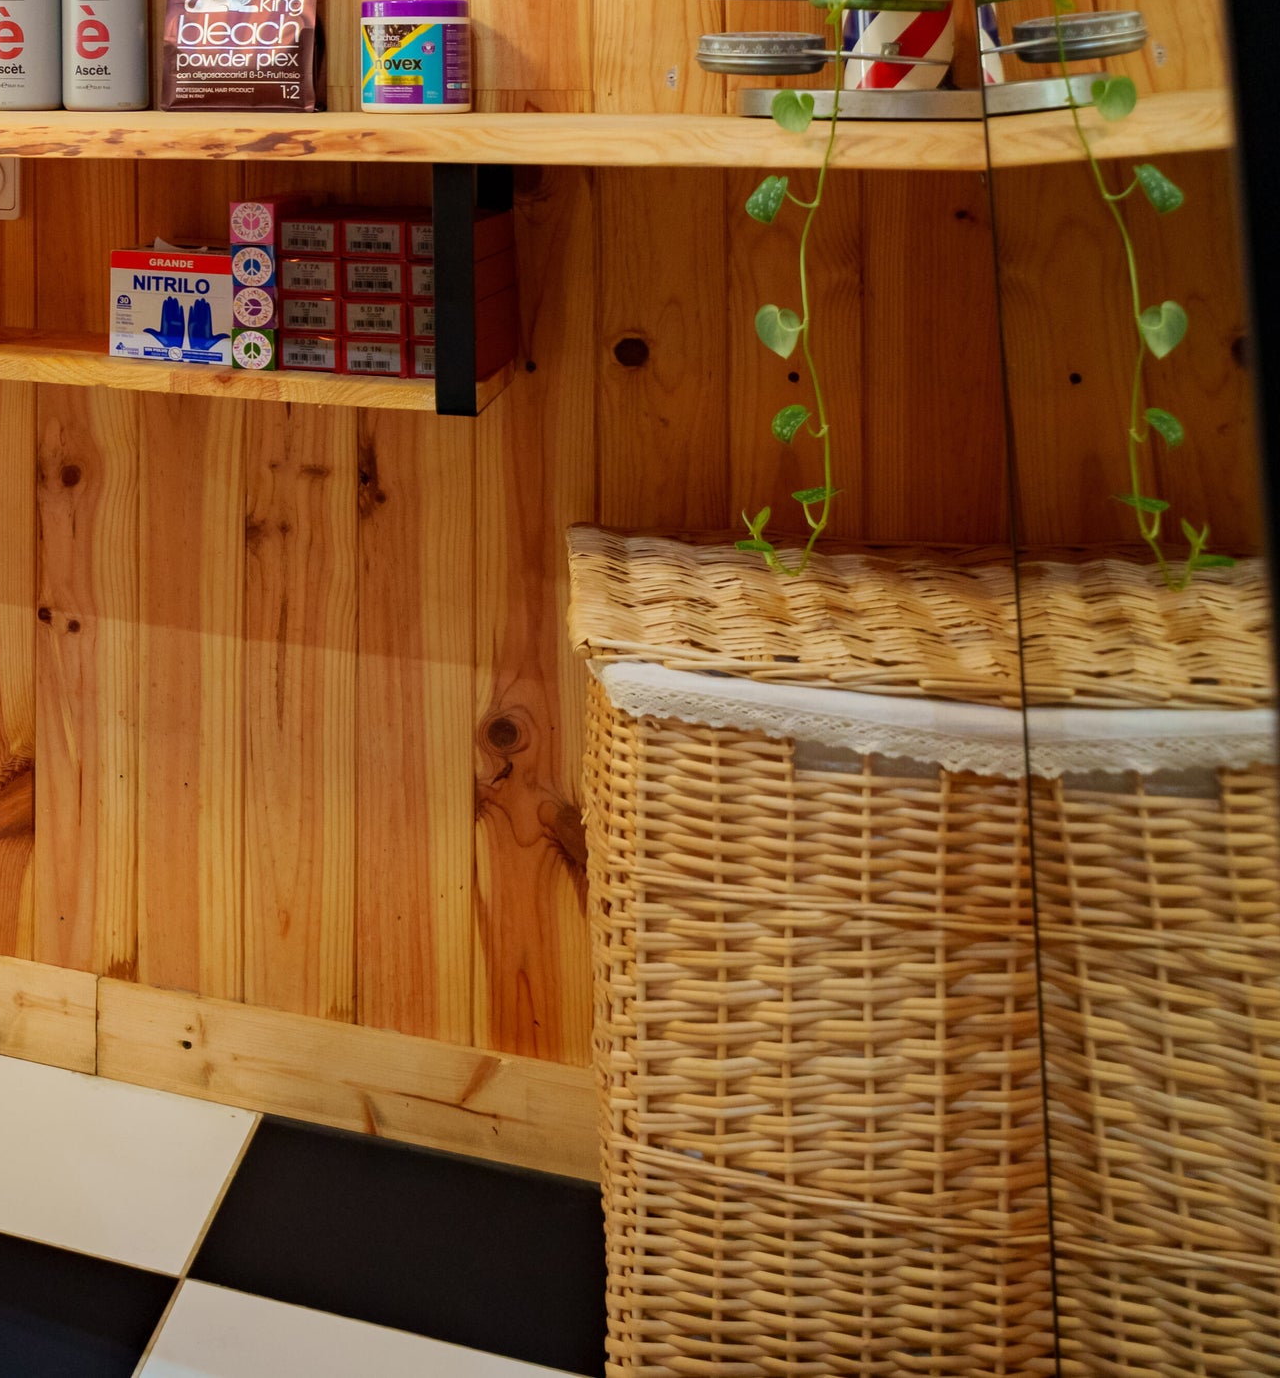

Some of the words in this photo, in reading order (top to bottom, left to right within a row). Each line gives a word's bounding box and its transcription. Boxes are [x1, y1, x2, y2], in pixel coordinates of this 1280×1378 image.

[177, 13, 300, 46] bleach
[176, 49, 252, 71] powder
[256, 49, 298, 71] plex
[375, 59, 422, 70] novex
[75, 65, 111, 75] Ascèt.
[176, 71, 191, 79] con
[192, 71, 248, 80] oligosaccaridi
[280, 84, 300, 99] 1:2
[149, 257, 194, 269] GRANDE
[132, 274, 210, 295] NITRILO
[119, 296, 129, 304] 30
